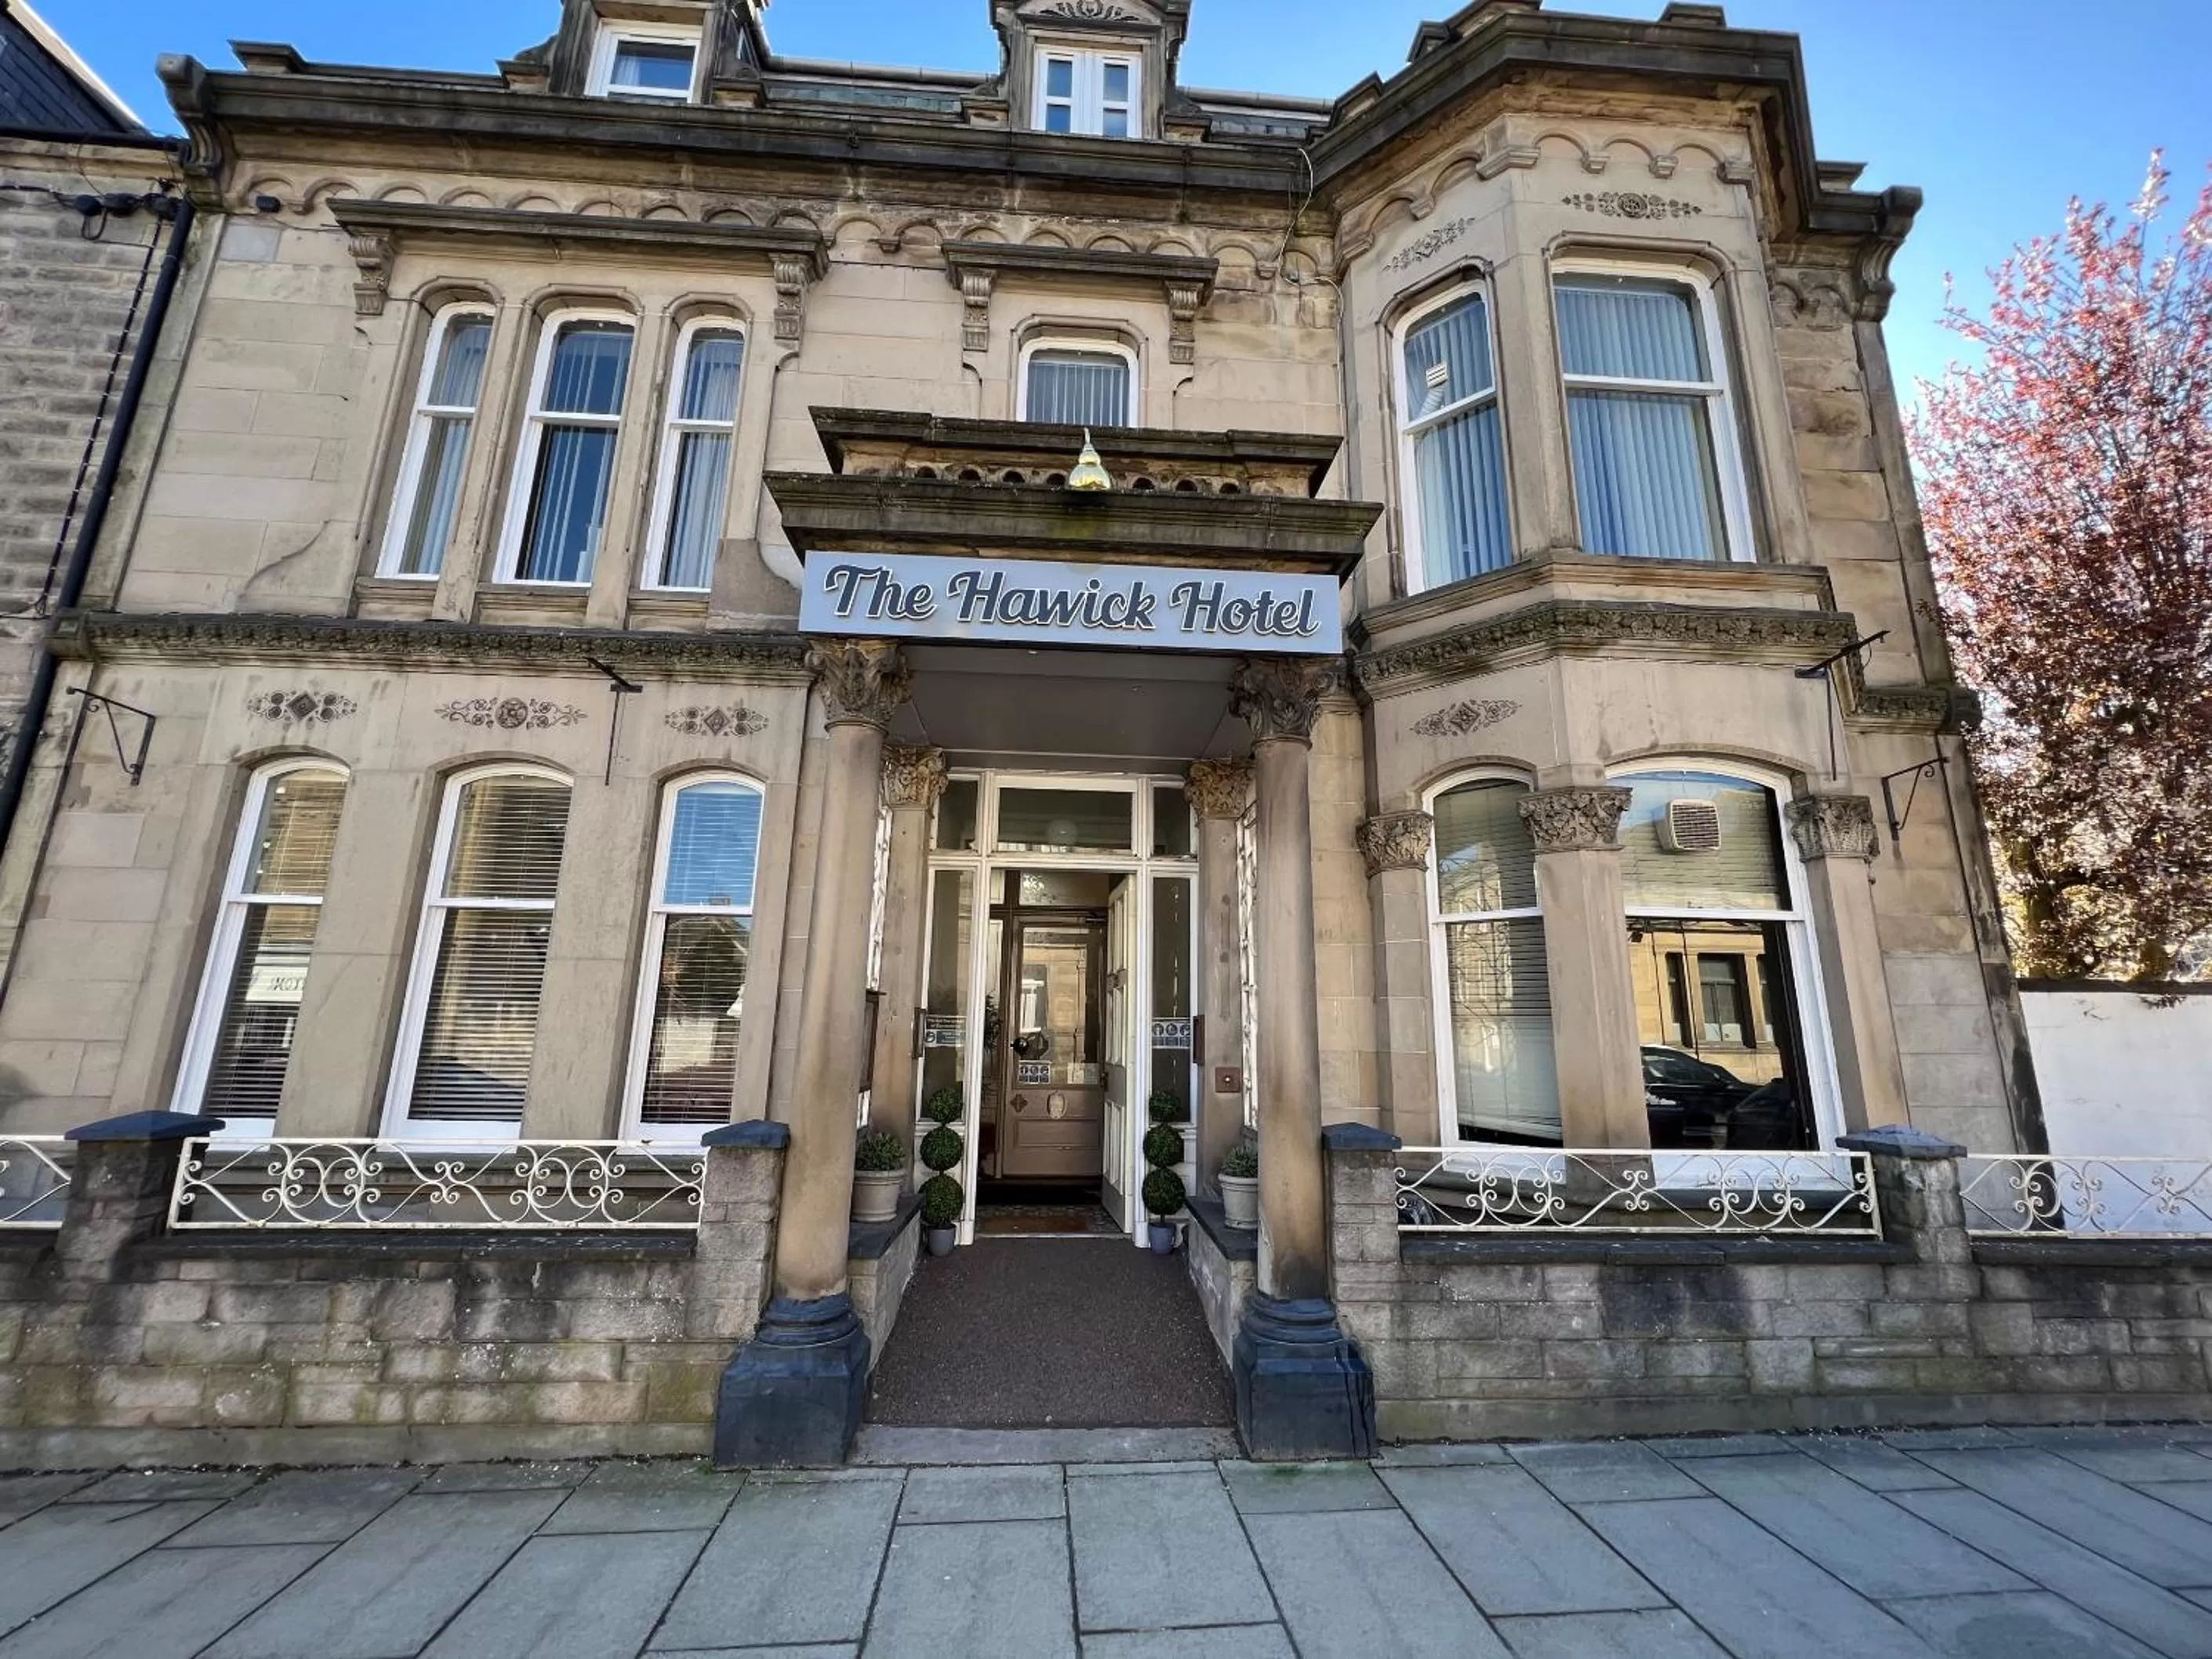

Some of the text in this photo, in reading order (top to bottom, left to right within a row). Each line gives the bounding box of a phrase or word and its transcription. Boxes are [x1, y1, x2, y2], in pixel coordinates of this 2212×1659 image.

[824, 564, 1322, 637] The Hawick Hotel
